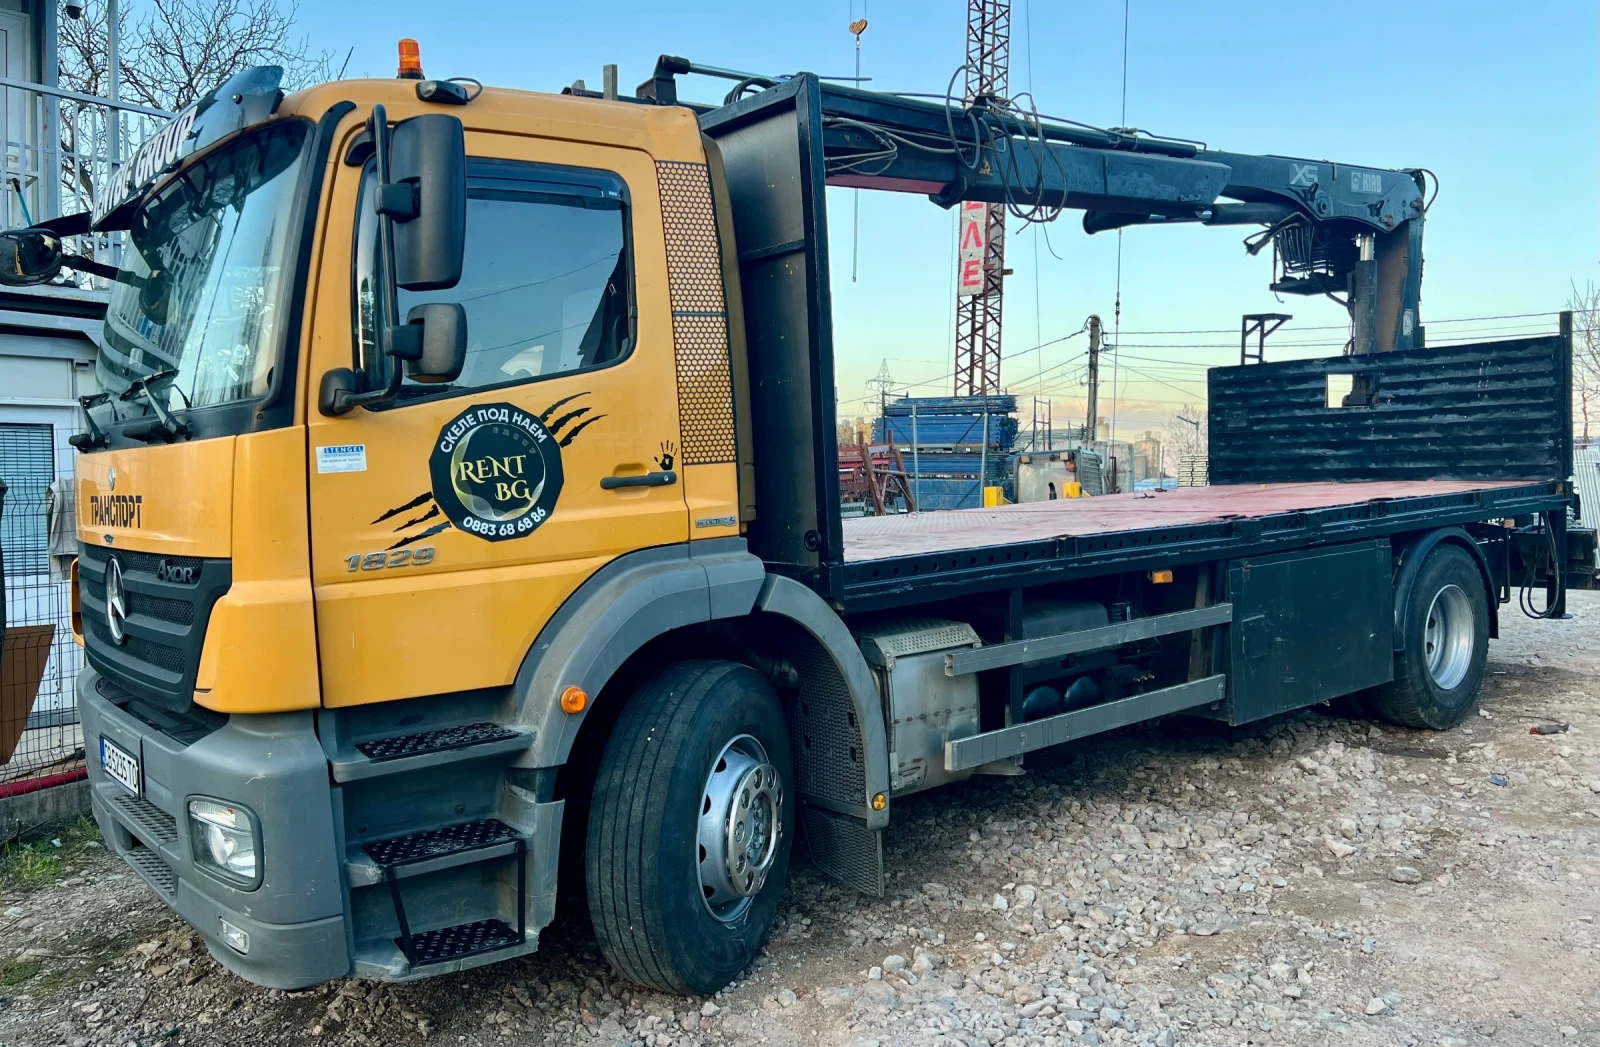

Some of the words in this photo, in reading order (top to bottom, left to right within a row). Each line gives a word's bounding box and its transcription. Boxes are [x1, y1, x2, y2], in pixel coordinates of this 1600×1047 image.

[135, 106, 198, 188] GROUP
[1290, 164, 1318, 187] XS
[1362, 173, 1382, 193] HIAB
[440, 413, 477, 453] СКЕЛЕ
[477, 408, 509, 423] ПОД
[512, 412, 548, 444] НАЕМ
[459, 454, 527, 484] RENT
[494, 480, 535, 501] BG
[90, 494, 142, 529] ТРАНСПОРТ
[463, 516, 496, 536] 0883
[499, 523, 515, 536] 68
[517, 517, 533, 532] 68
[530, 506, 546, 520] 86
[344, 545, 435, 573] 1829
